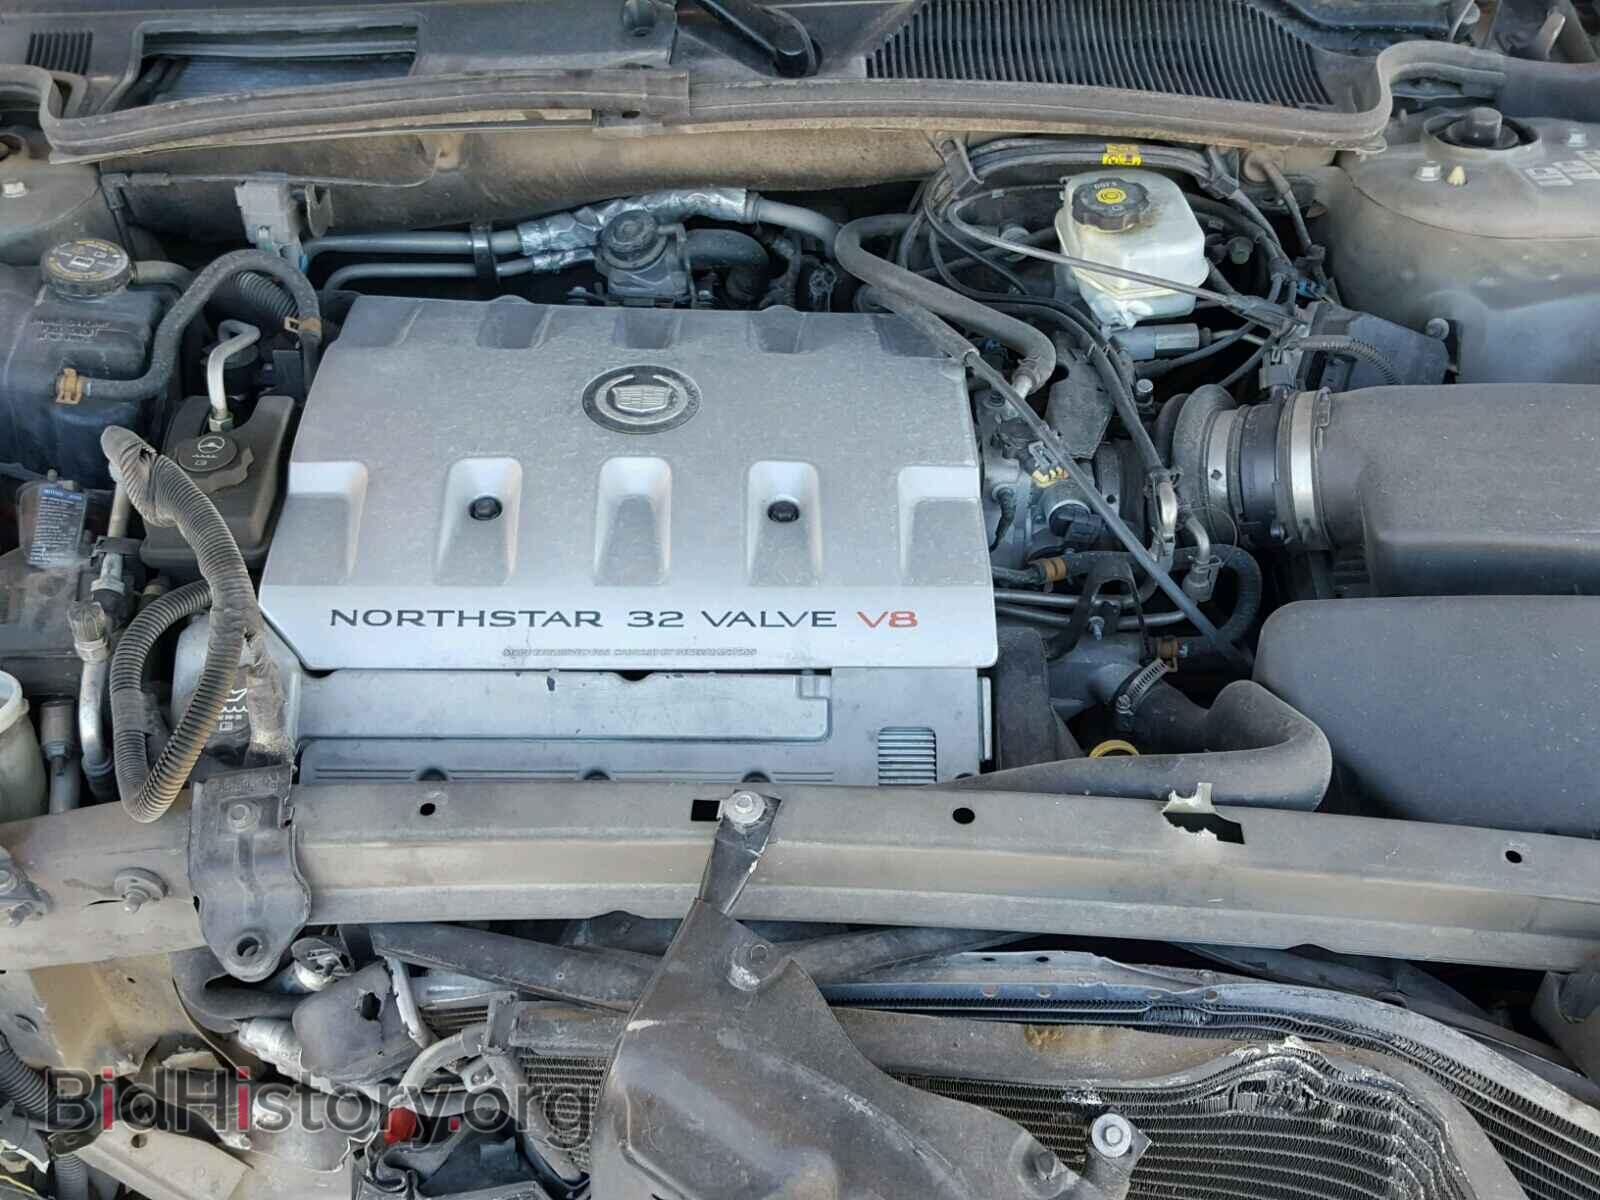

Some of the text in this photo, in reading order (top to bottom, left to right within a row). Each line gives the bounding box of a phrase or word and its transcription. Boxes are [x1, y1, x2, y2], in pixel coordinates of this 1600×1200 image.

[330, 609, 918, 629] NORTHSTAR 32 VALVE V8
